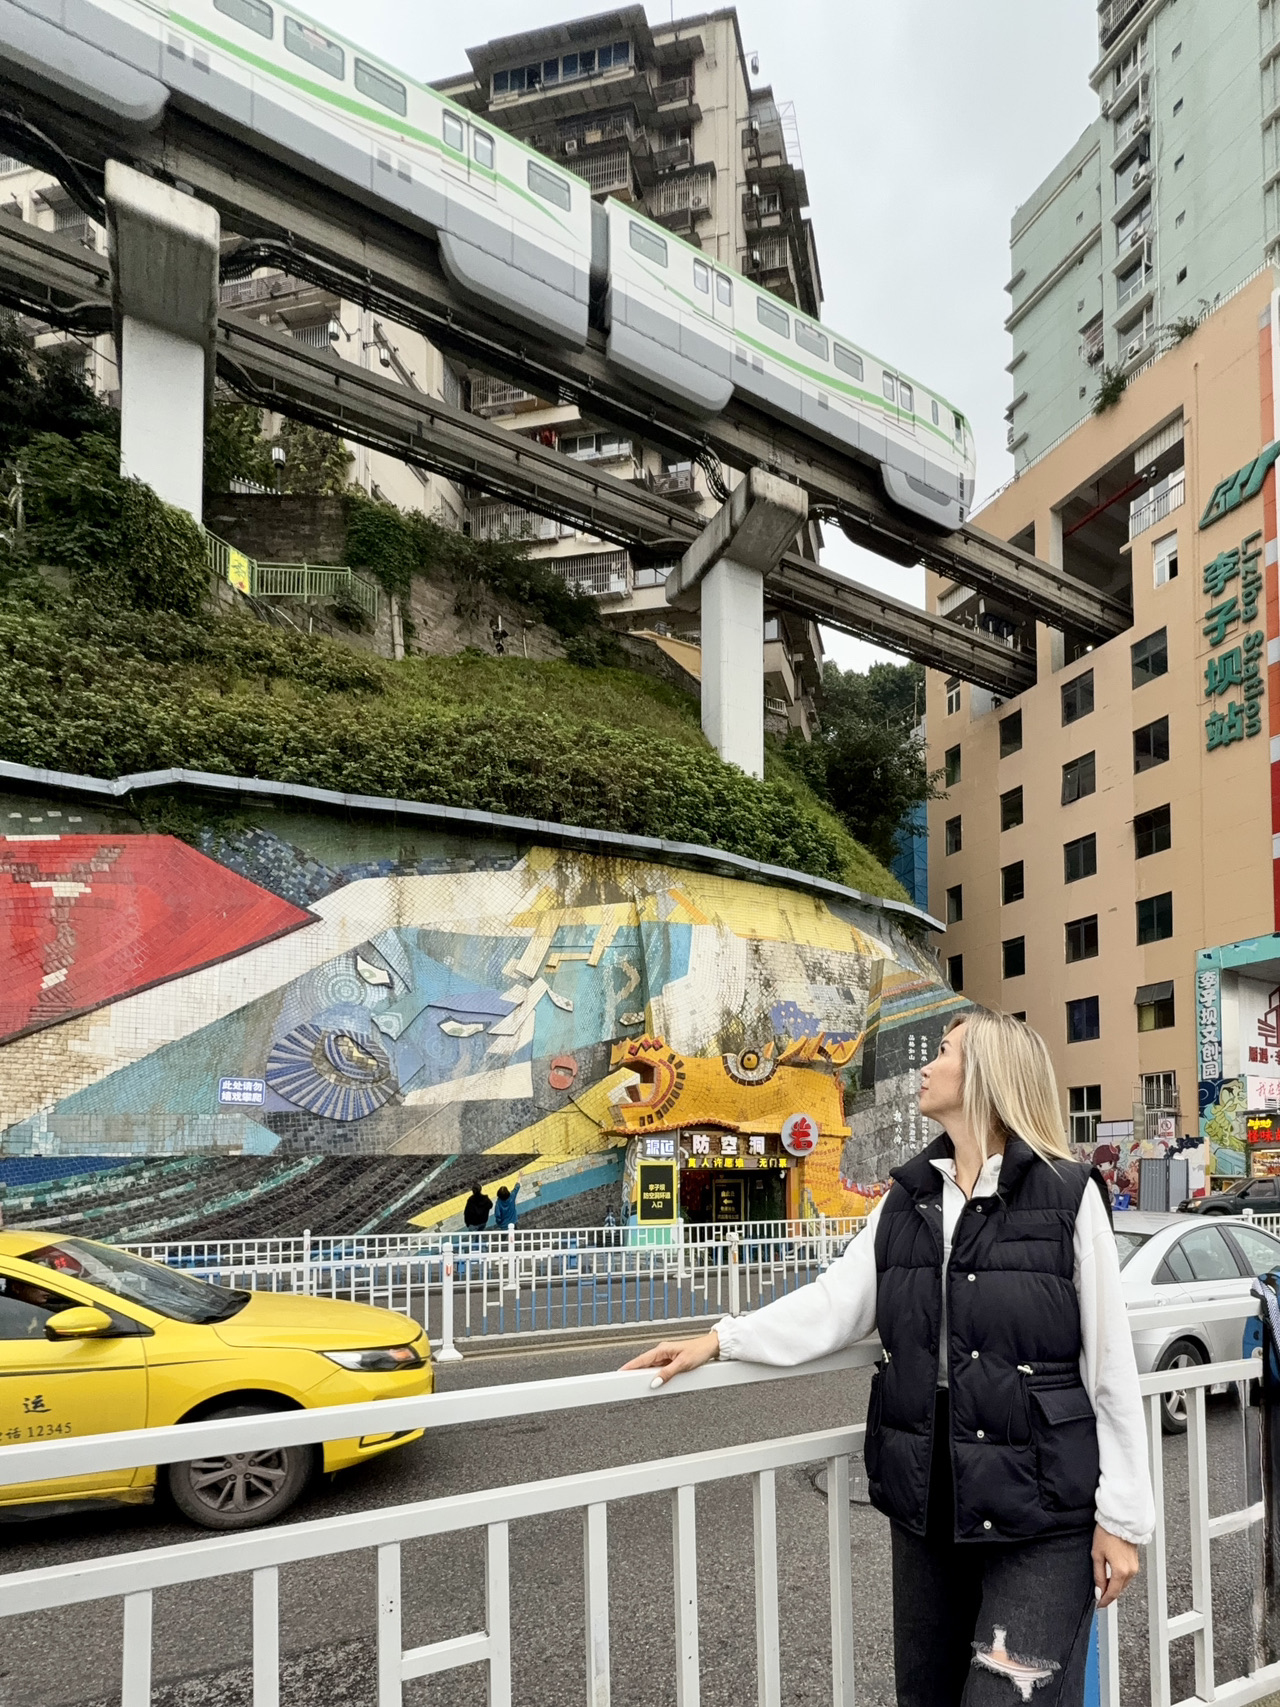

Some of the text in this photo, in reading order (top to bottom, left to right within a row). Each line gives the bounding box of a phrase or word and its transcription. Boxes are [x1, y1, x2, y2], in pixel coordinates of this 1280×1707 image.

[1241, 529, 1263, 624] Liziba
[1203, 546, 1243, 752] 李子坝站
[1242, 629, 1265, 738] Station
[1199, 971, 1220, 1080] 李子坝文创园
[222, 1080, 263, 1092] 此处请勿
[692, 1134, 766, 1155] 防空洞
[759, 1157, 788, 1169] 无门票
[651, 1201, 663, 1209] 入口
[23, 1394, 52, 1414] 运
[28, 1422, 72, 1438] 12345
